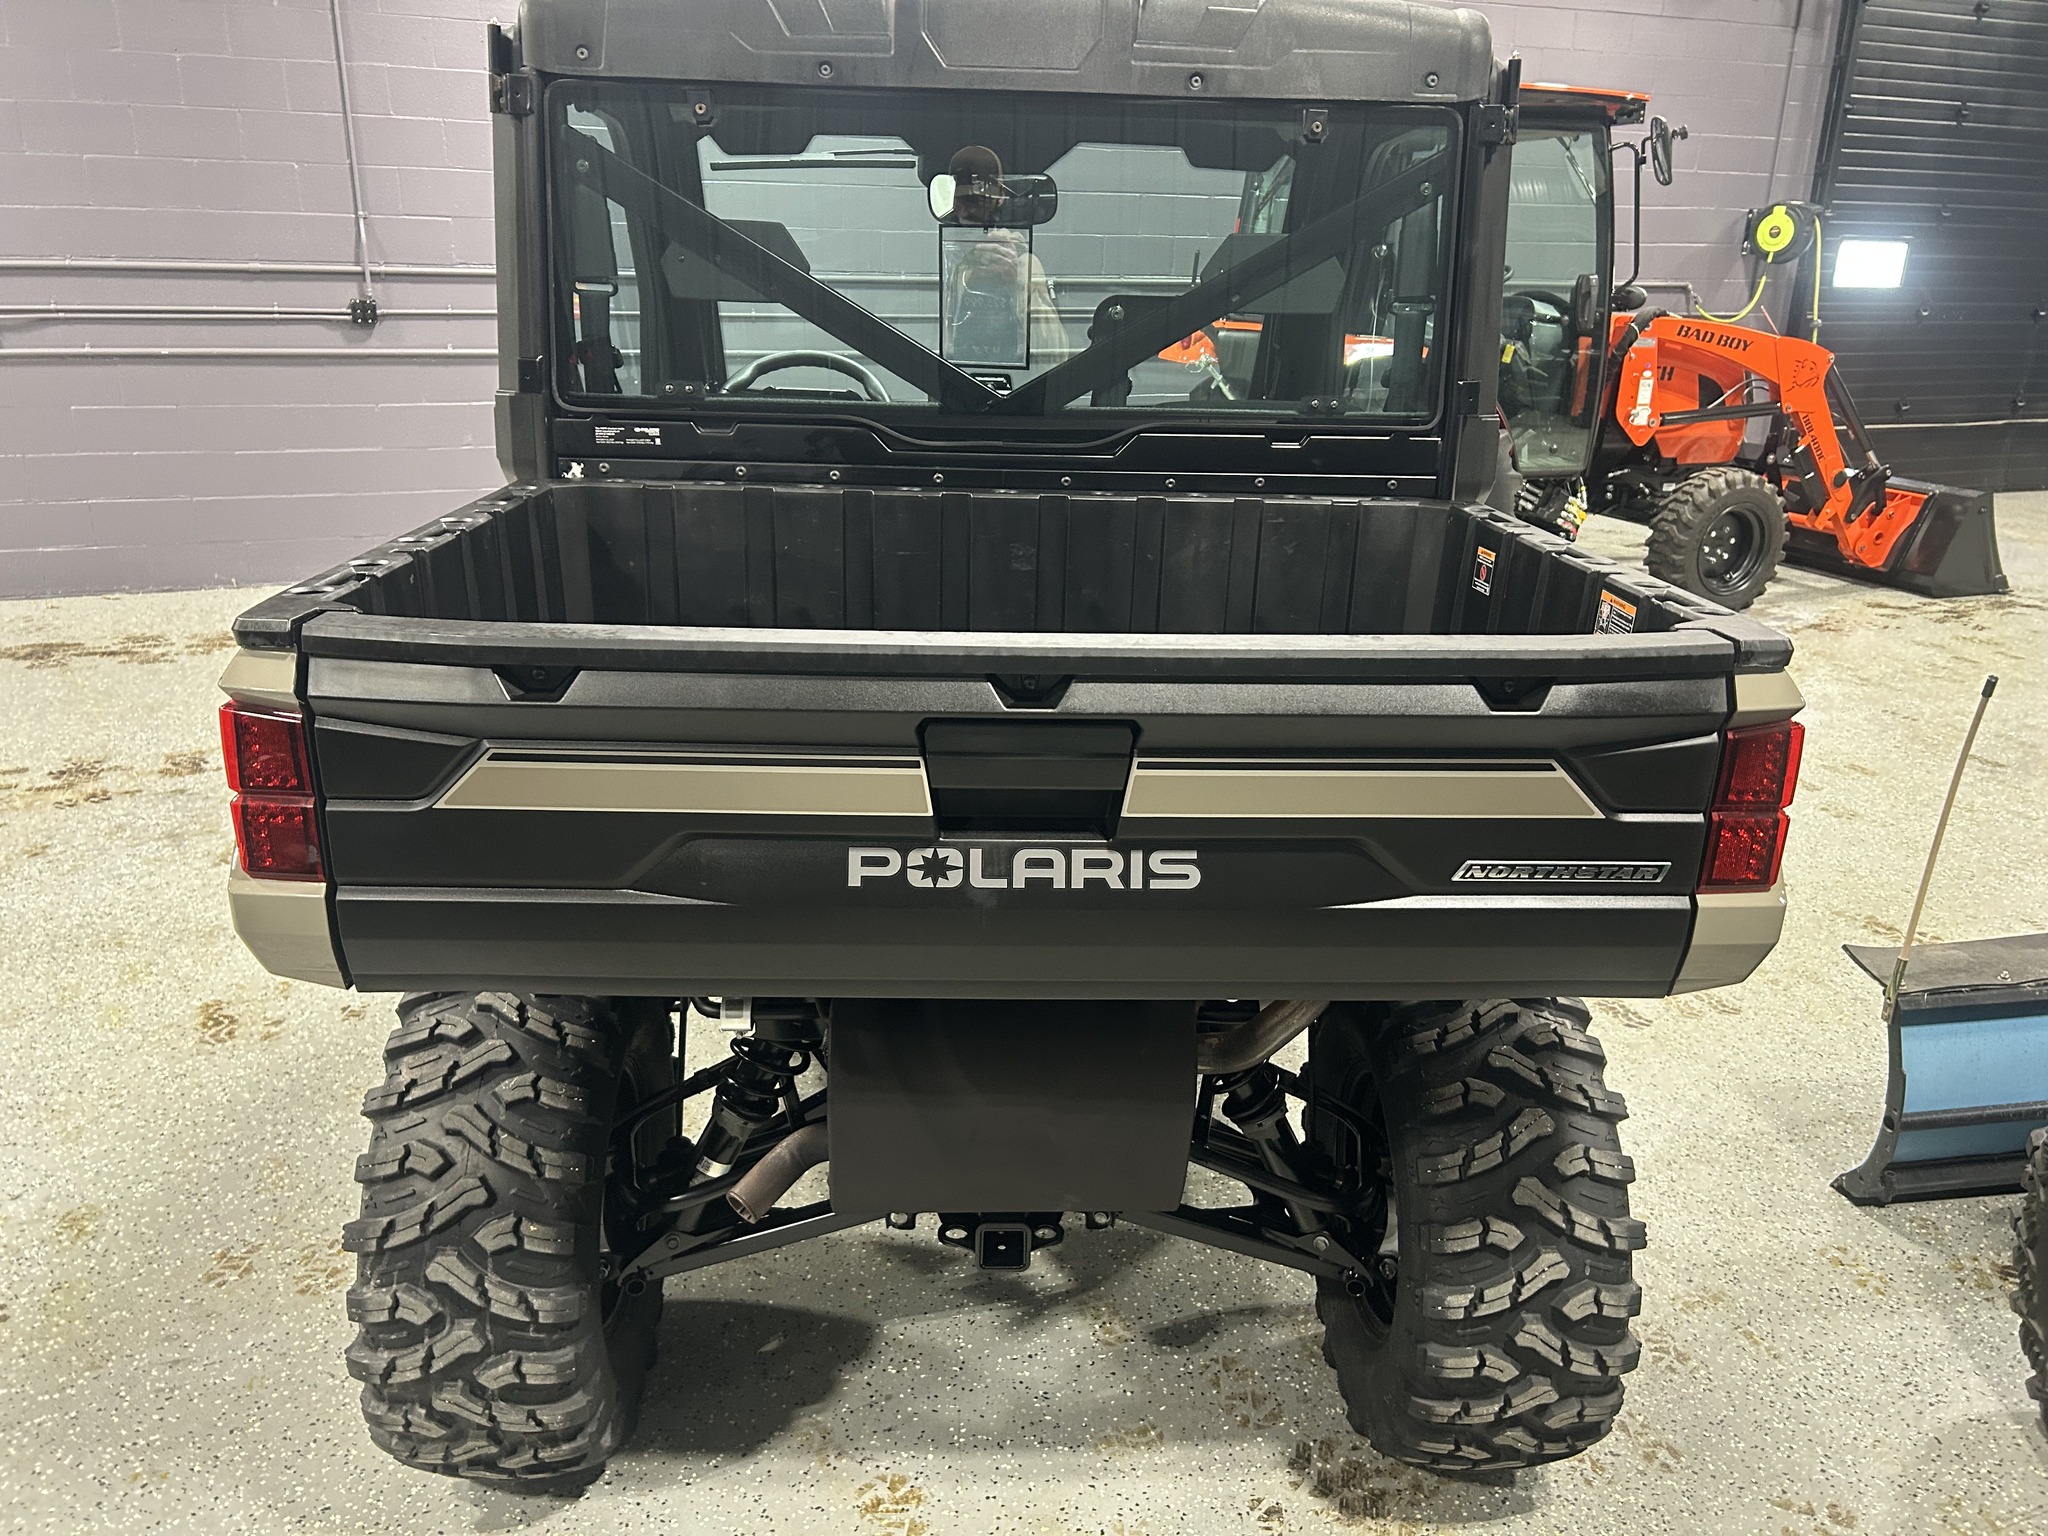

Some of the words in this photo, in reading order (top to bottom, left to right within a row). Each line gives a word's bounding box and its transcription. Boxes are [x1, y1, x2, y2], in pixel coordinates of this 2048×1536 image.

[1676, 325, 1715, 344] BAD
[1716, 334, 1754, 352] BOY
[847, 847, 1201, 889] POLARIS
[1464, 865, 1659, 879] NORTHSTAR
